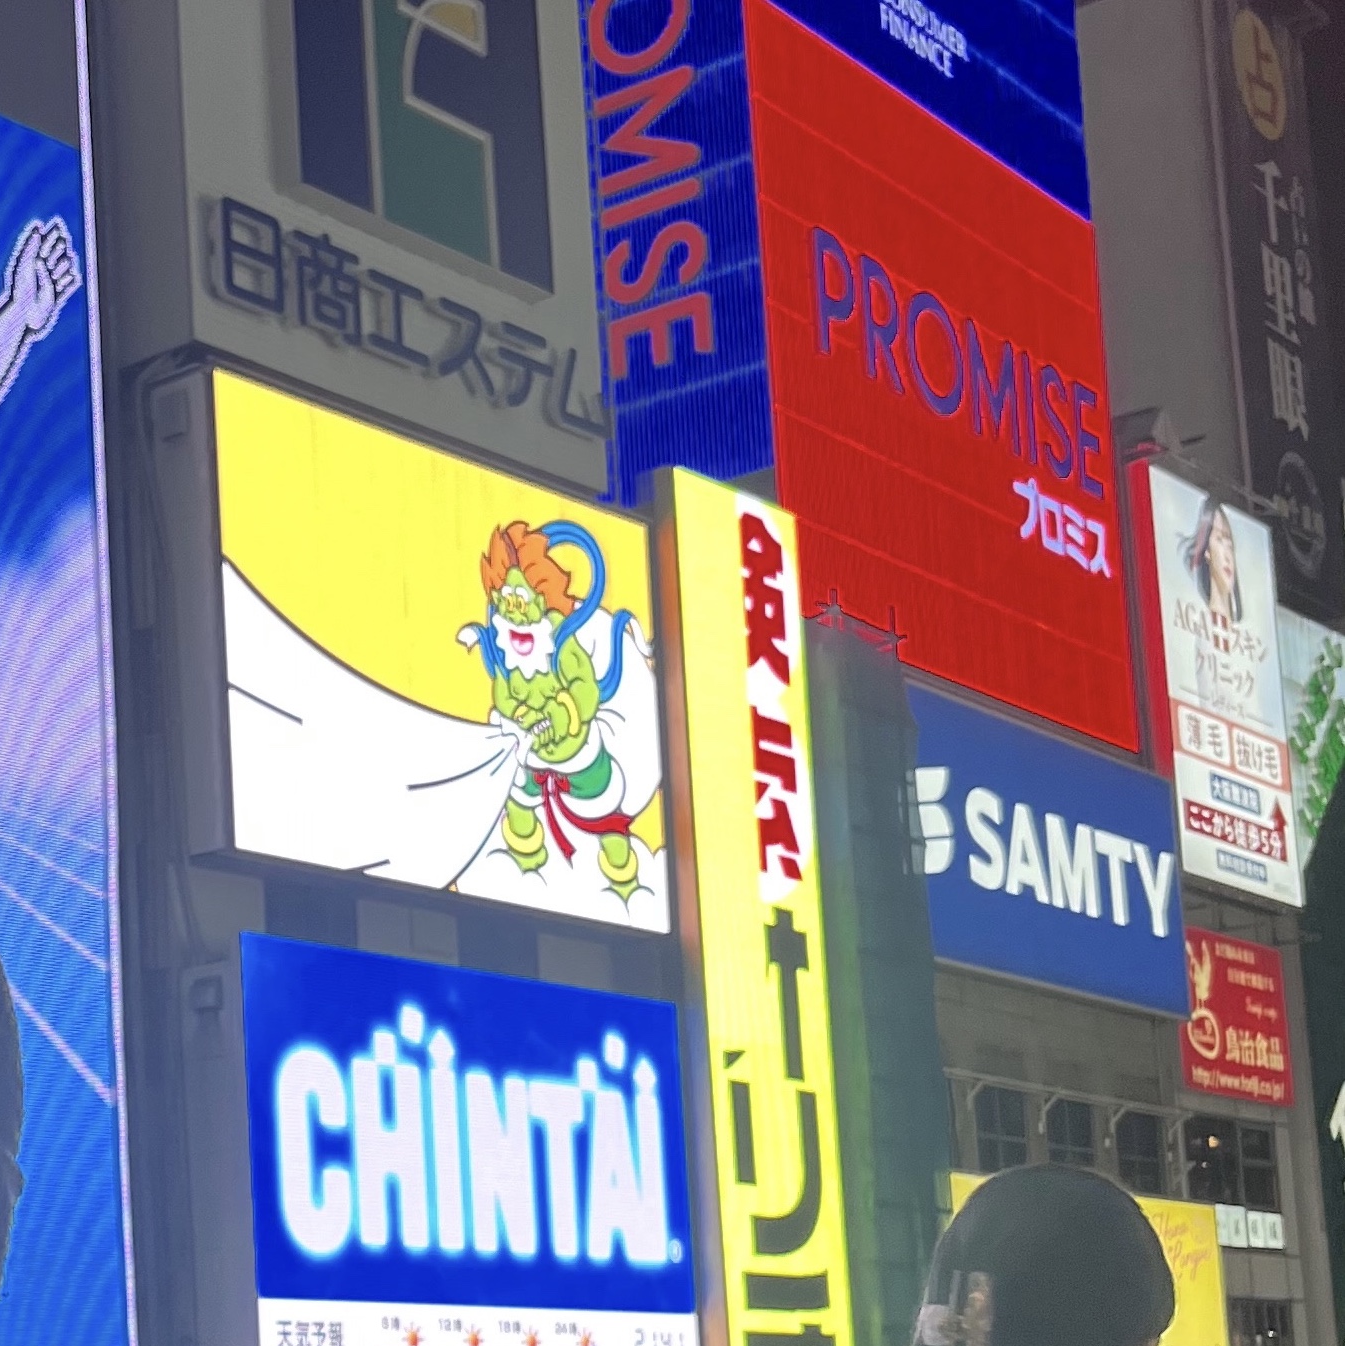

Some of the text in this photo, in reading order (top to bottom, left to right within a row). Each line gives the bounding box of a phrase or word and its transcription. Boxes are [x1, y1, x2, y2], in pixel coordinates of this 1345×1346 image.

[880, 2, 954, 78] FINANCE
[811, 226, 1105, 501] PROMISE
[1013, 478, 1111, 579] プロミス
[1236, 731, 1279, 781] 抜け毛
[964, 786, 1174, 938] SAMTY
